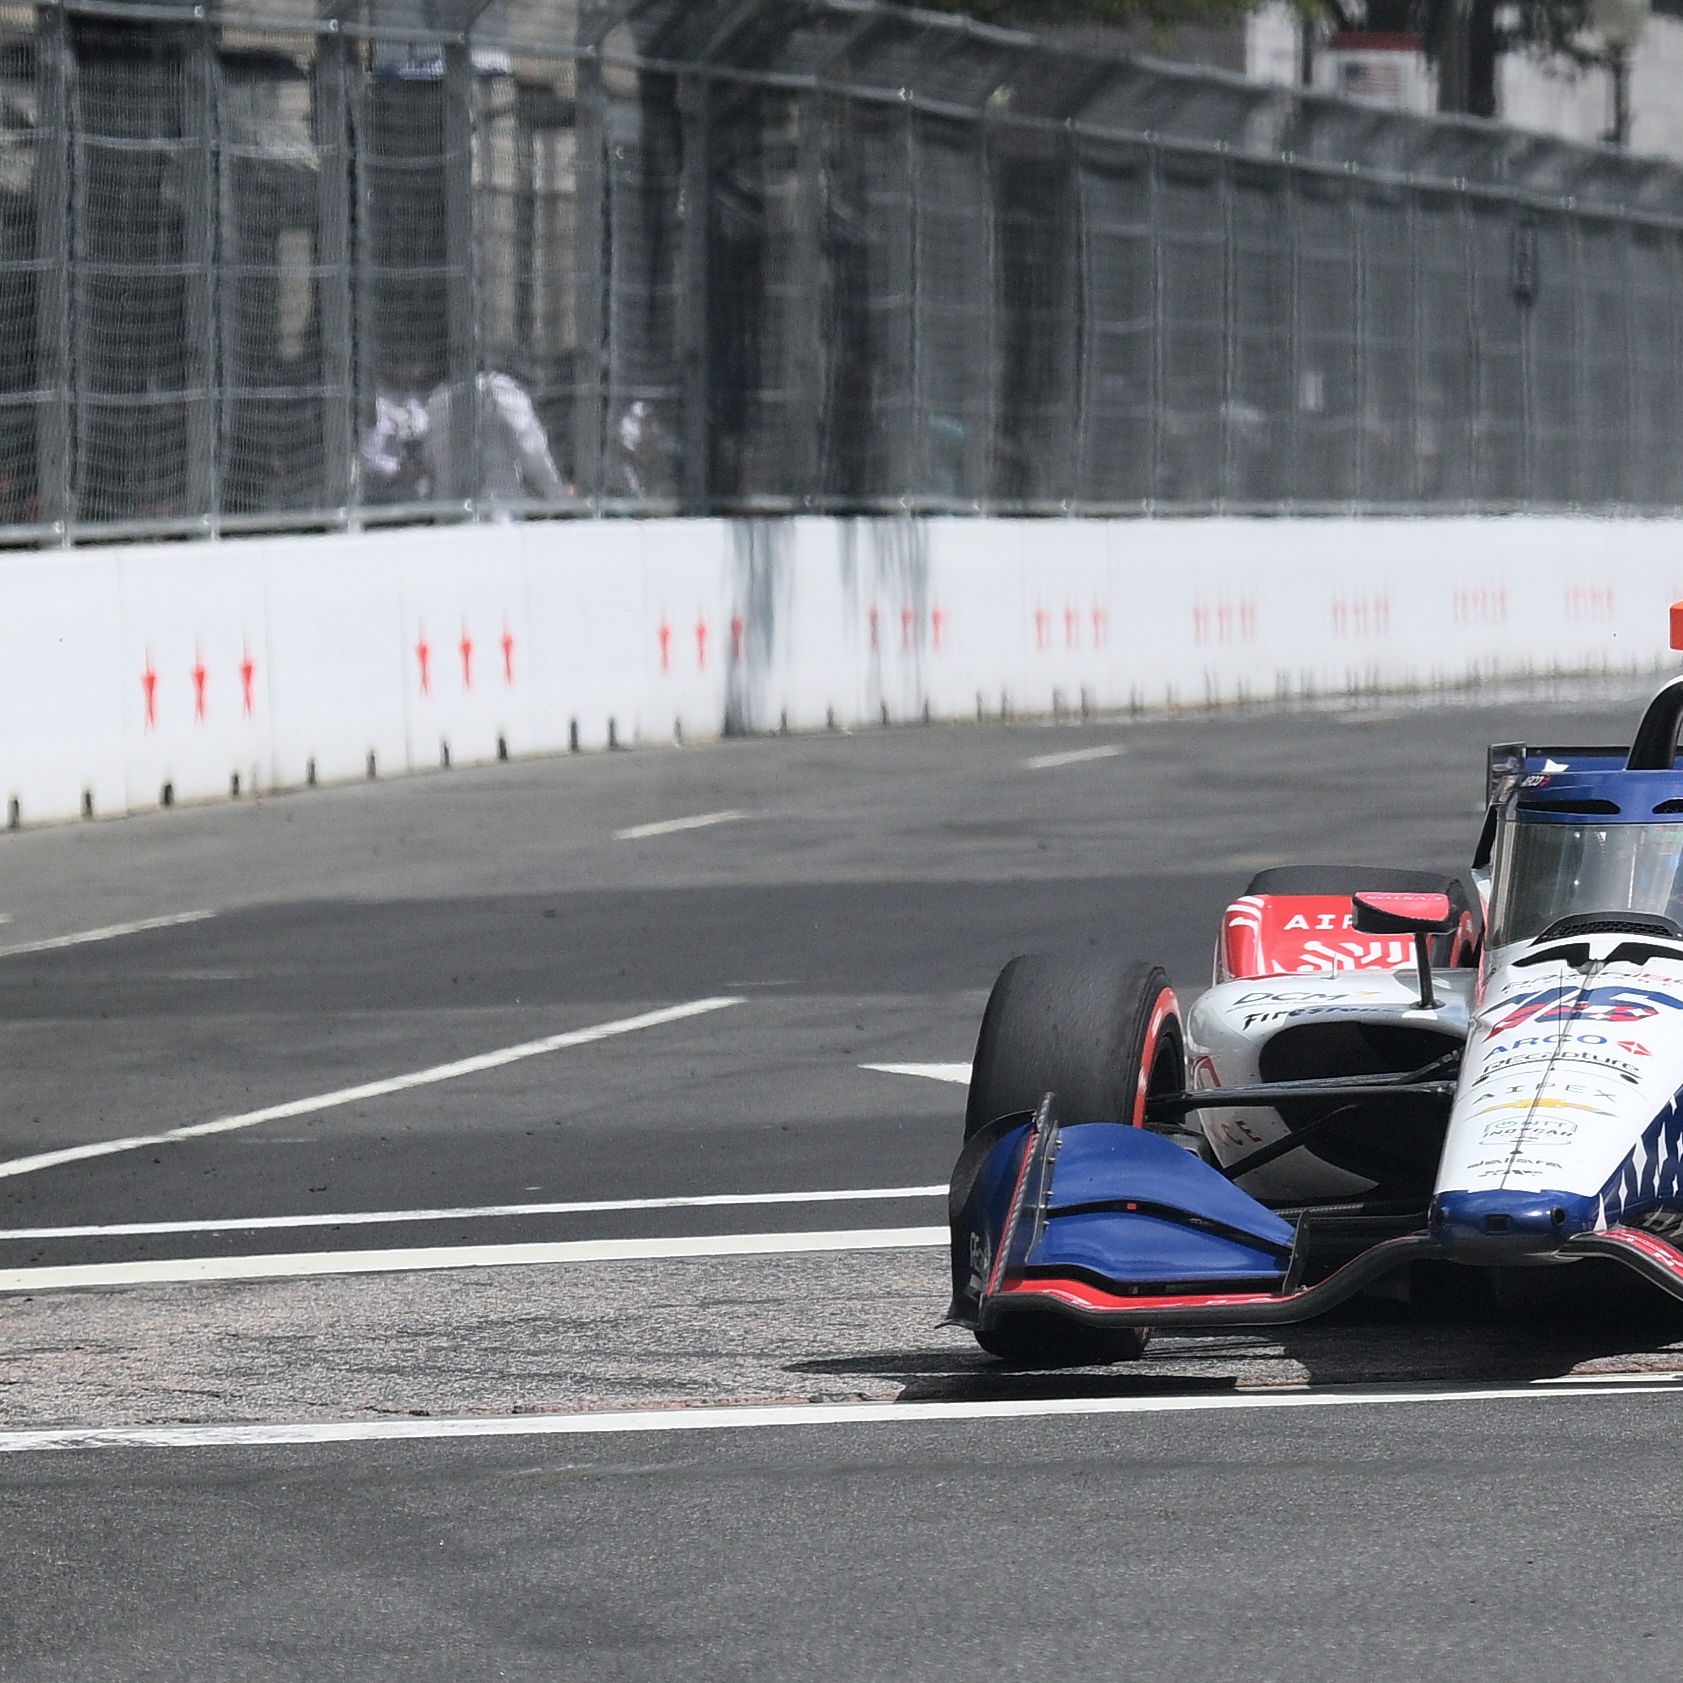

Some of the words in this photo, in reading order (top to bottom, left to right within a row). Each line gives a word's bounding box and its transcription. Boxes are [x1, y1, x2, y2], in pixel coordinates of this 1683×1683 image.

[1283, 914, 1352, 931] AIP
[1482, 1033, 1608, 1062] ARCO
[1472, 1081, 1616, 1106] AIPEX
